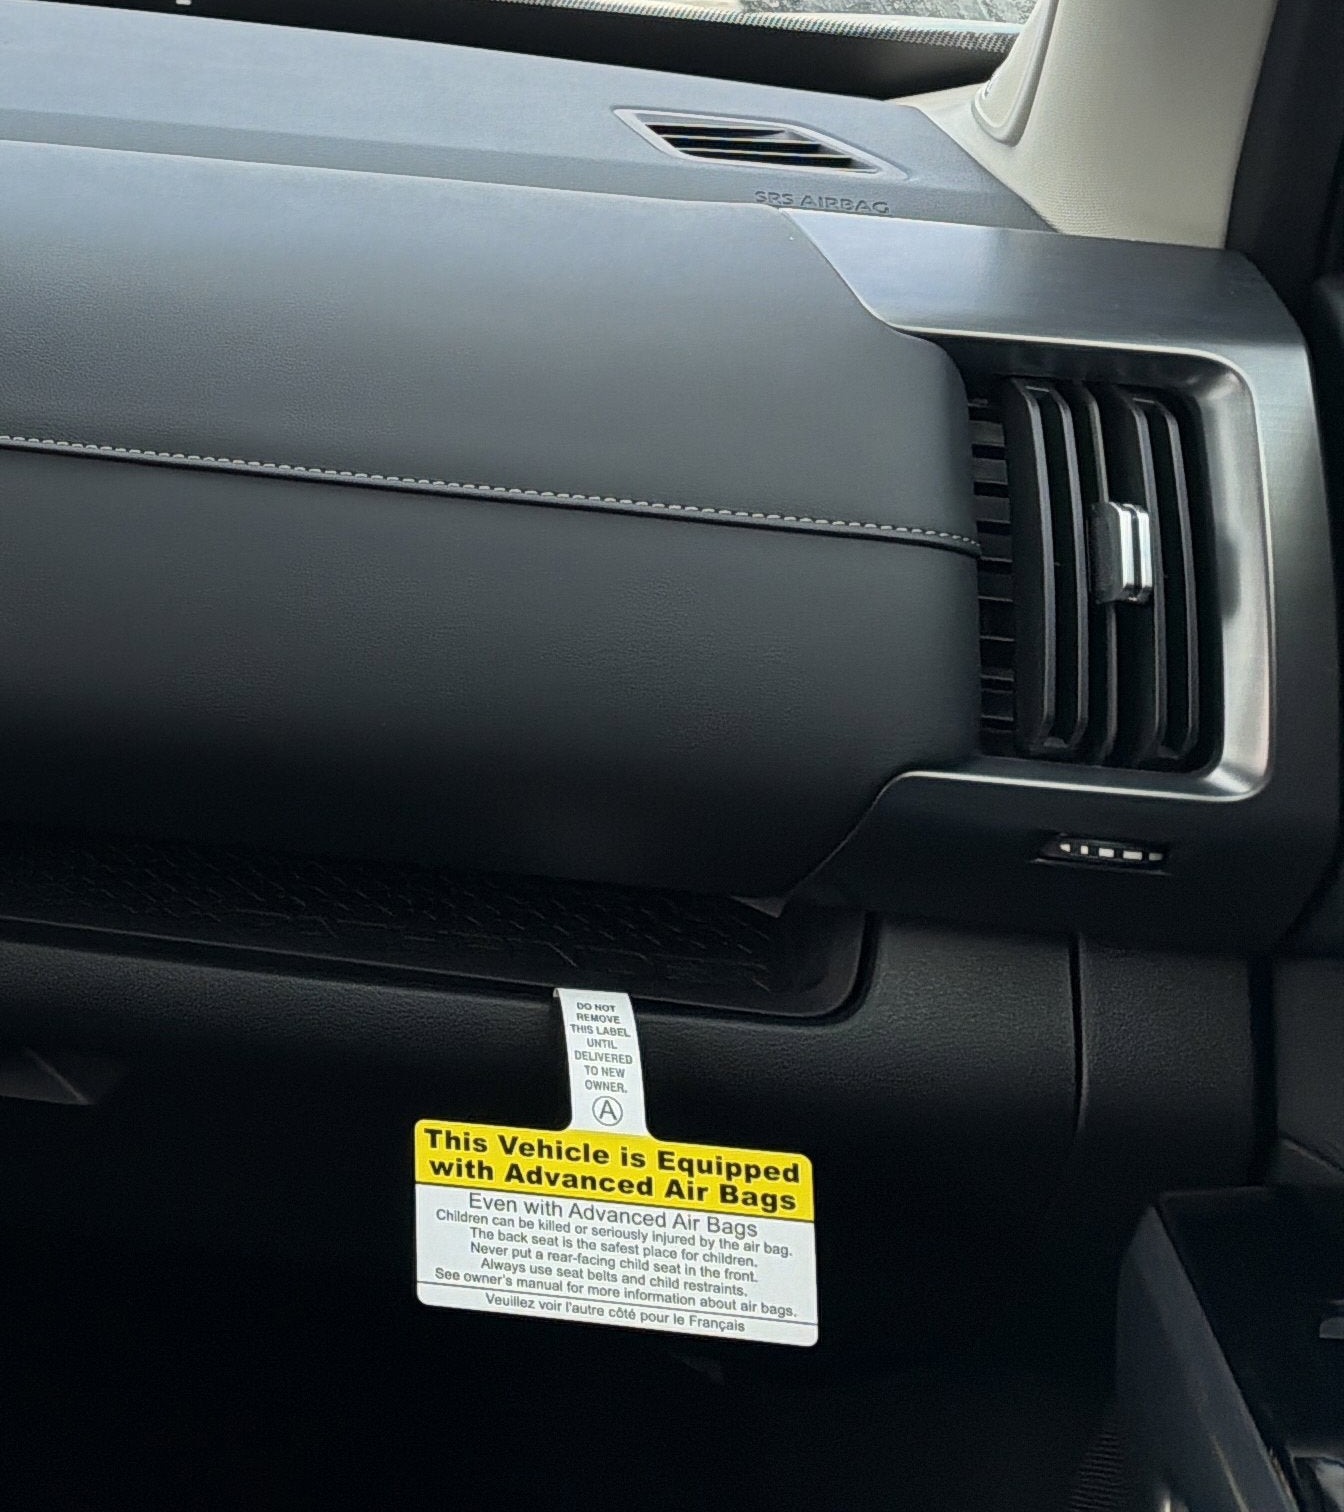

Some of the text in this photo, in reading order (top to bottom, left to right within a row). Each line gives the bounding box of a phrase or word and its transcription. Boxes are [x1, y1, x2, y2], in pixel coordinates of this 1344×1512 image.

[754, 190, 890, 214] SRS AIRBAG
[576, 1002, 616, 1013] DO NOT
[576, 1012, 621, 1024] REMOVE
[570, 1024, 631, 1038] THIS LABEL
[586, 1038, 618, 1050] UNTIL
[574, 1050, 633, 1065] DELIVERED
[584, 1065, 625, 1078] TO NEW
[584, 1080, 628, 1094] OWNER.
[599, 1100, 617, 1120] A
[424, 1128, 800, 1183] This Vehicle is Equipped
[429, 1158, 797, 1213] with Advanced Air Bags
[469, 1192, 758, 1240] Even with Advanced Air Bags
[436, 1208, 793, 1258] Children can be killed or seriously injured by the air bag.
[470, 1226, 758, 1268] The back seat is the safest place for children.
[470, 1242, 758, 1283] Never put a rear-facing child seat in the front.
[481, 1258, 748, 1297] Always use seat belts and child restraints.
[435, 1267, 798, 1318] See owner's manual for more information about air bags.
[486, 1292, 746, 1332] Veuillez voir l'autre côté pour le Français
